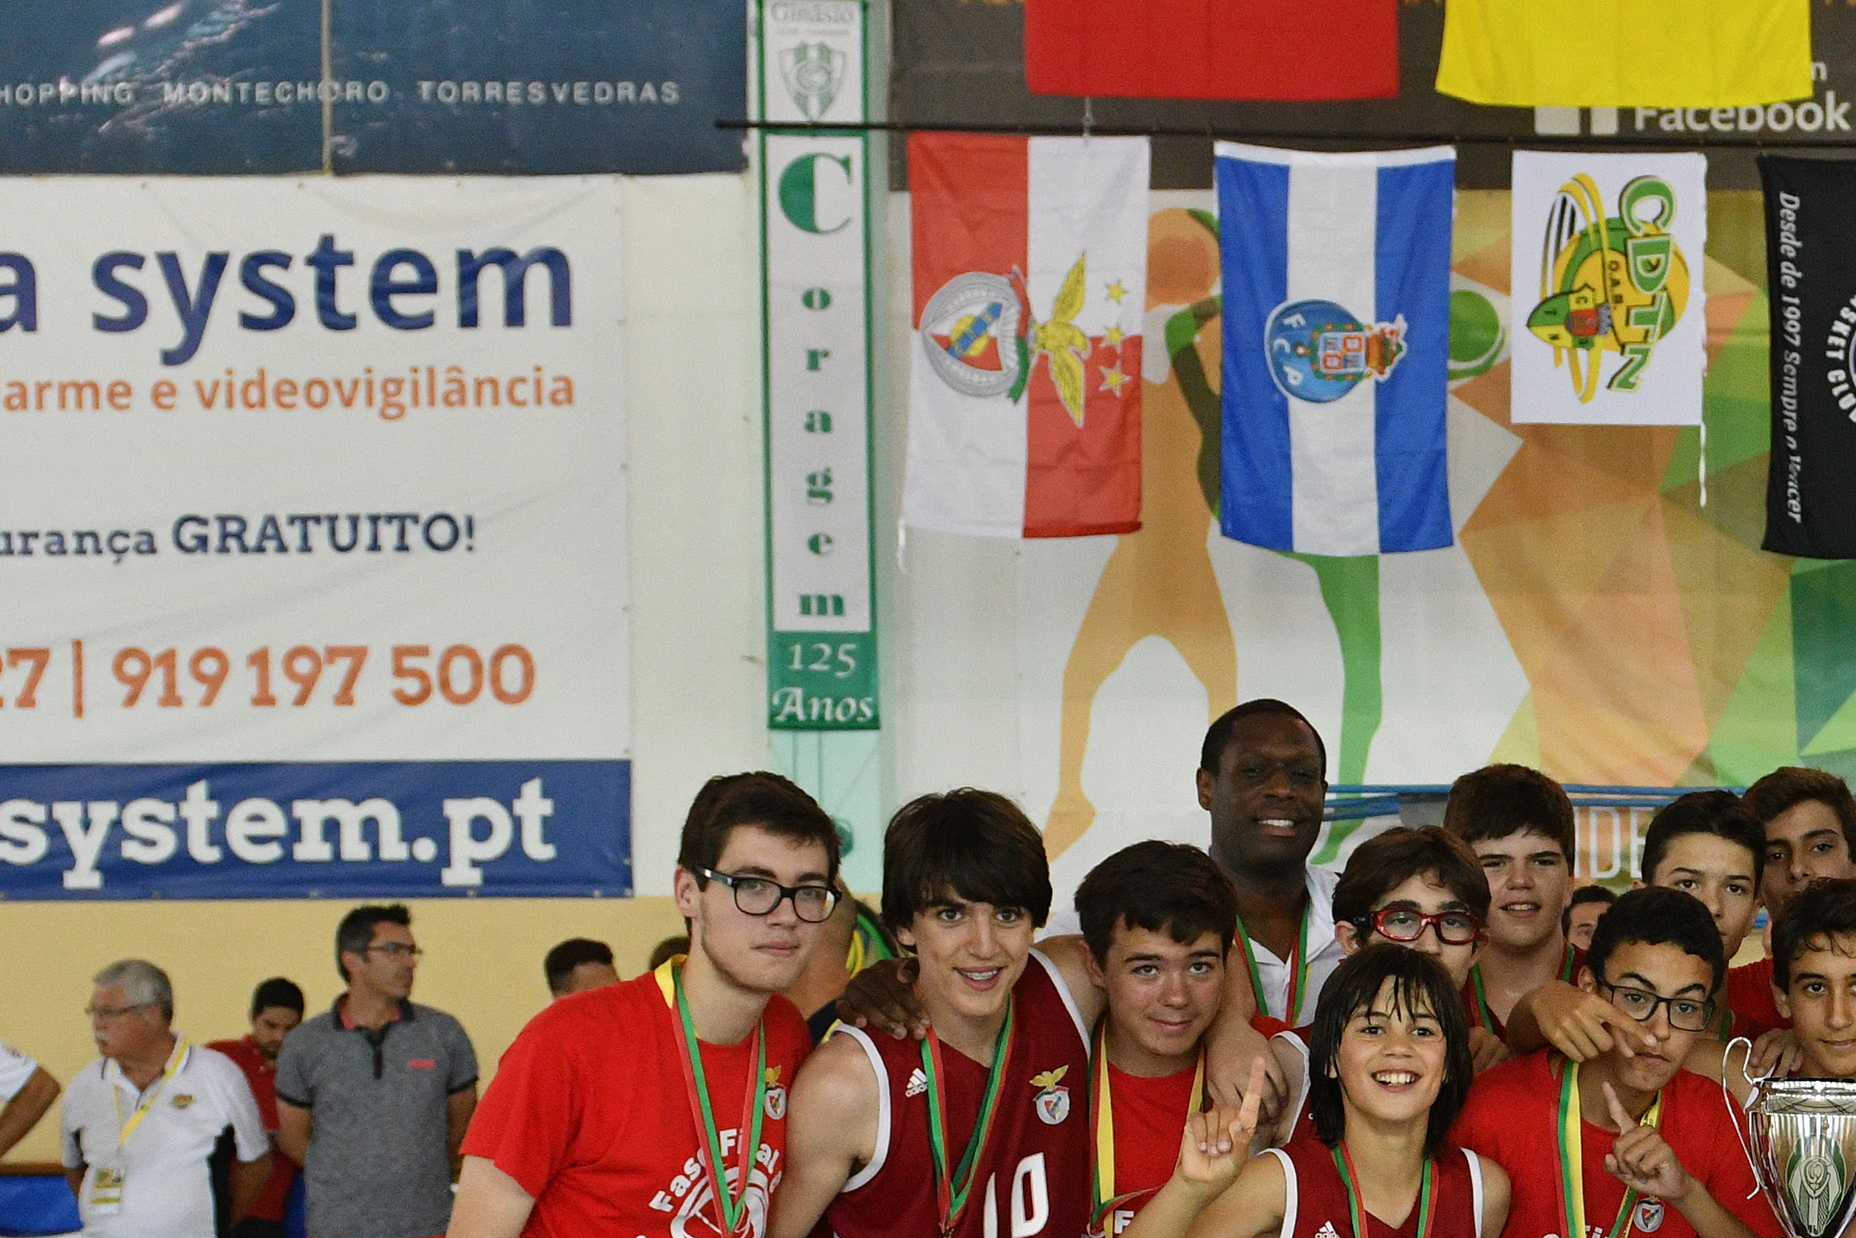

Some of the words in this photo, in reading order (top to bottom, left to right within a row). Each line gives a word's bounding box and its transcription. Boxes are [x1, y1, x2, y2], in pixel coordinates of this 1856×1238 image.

[163, 82, 389, 104] MONTECHORO
[1779, 190, 1802, 250] Desde
[92, 234, 573, 367] system
[1780, 263, 1802, 289] de
[4, 377, 133, 411] arme
[151, 378, 178, 411] e
[194, 366, 576, 421] videovigilância
[778, 152, 853, 618] Coragem
[172, 512, 477, 556] GRATUITO!
[112, 646, 231, 708] 919
[248, 646, 369, 708] 197
[390, 643, 537, 707] 500
[788, 641, 858, 677] 125
[771, 685, 875, 725] Anos
